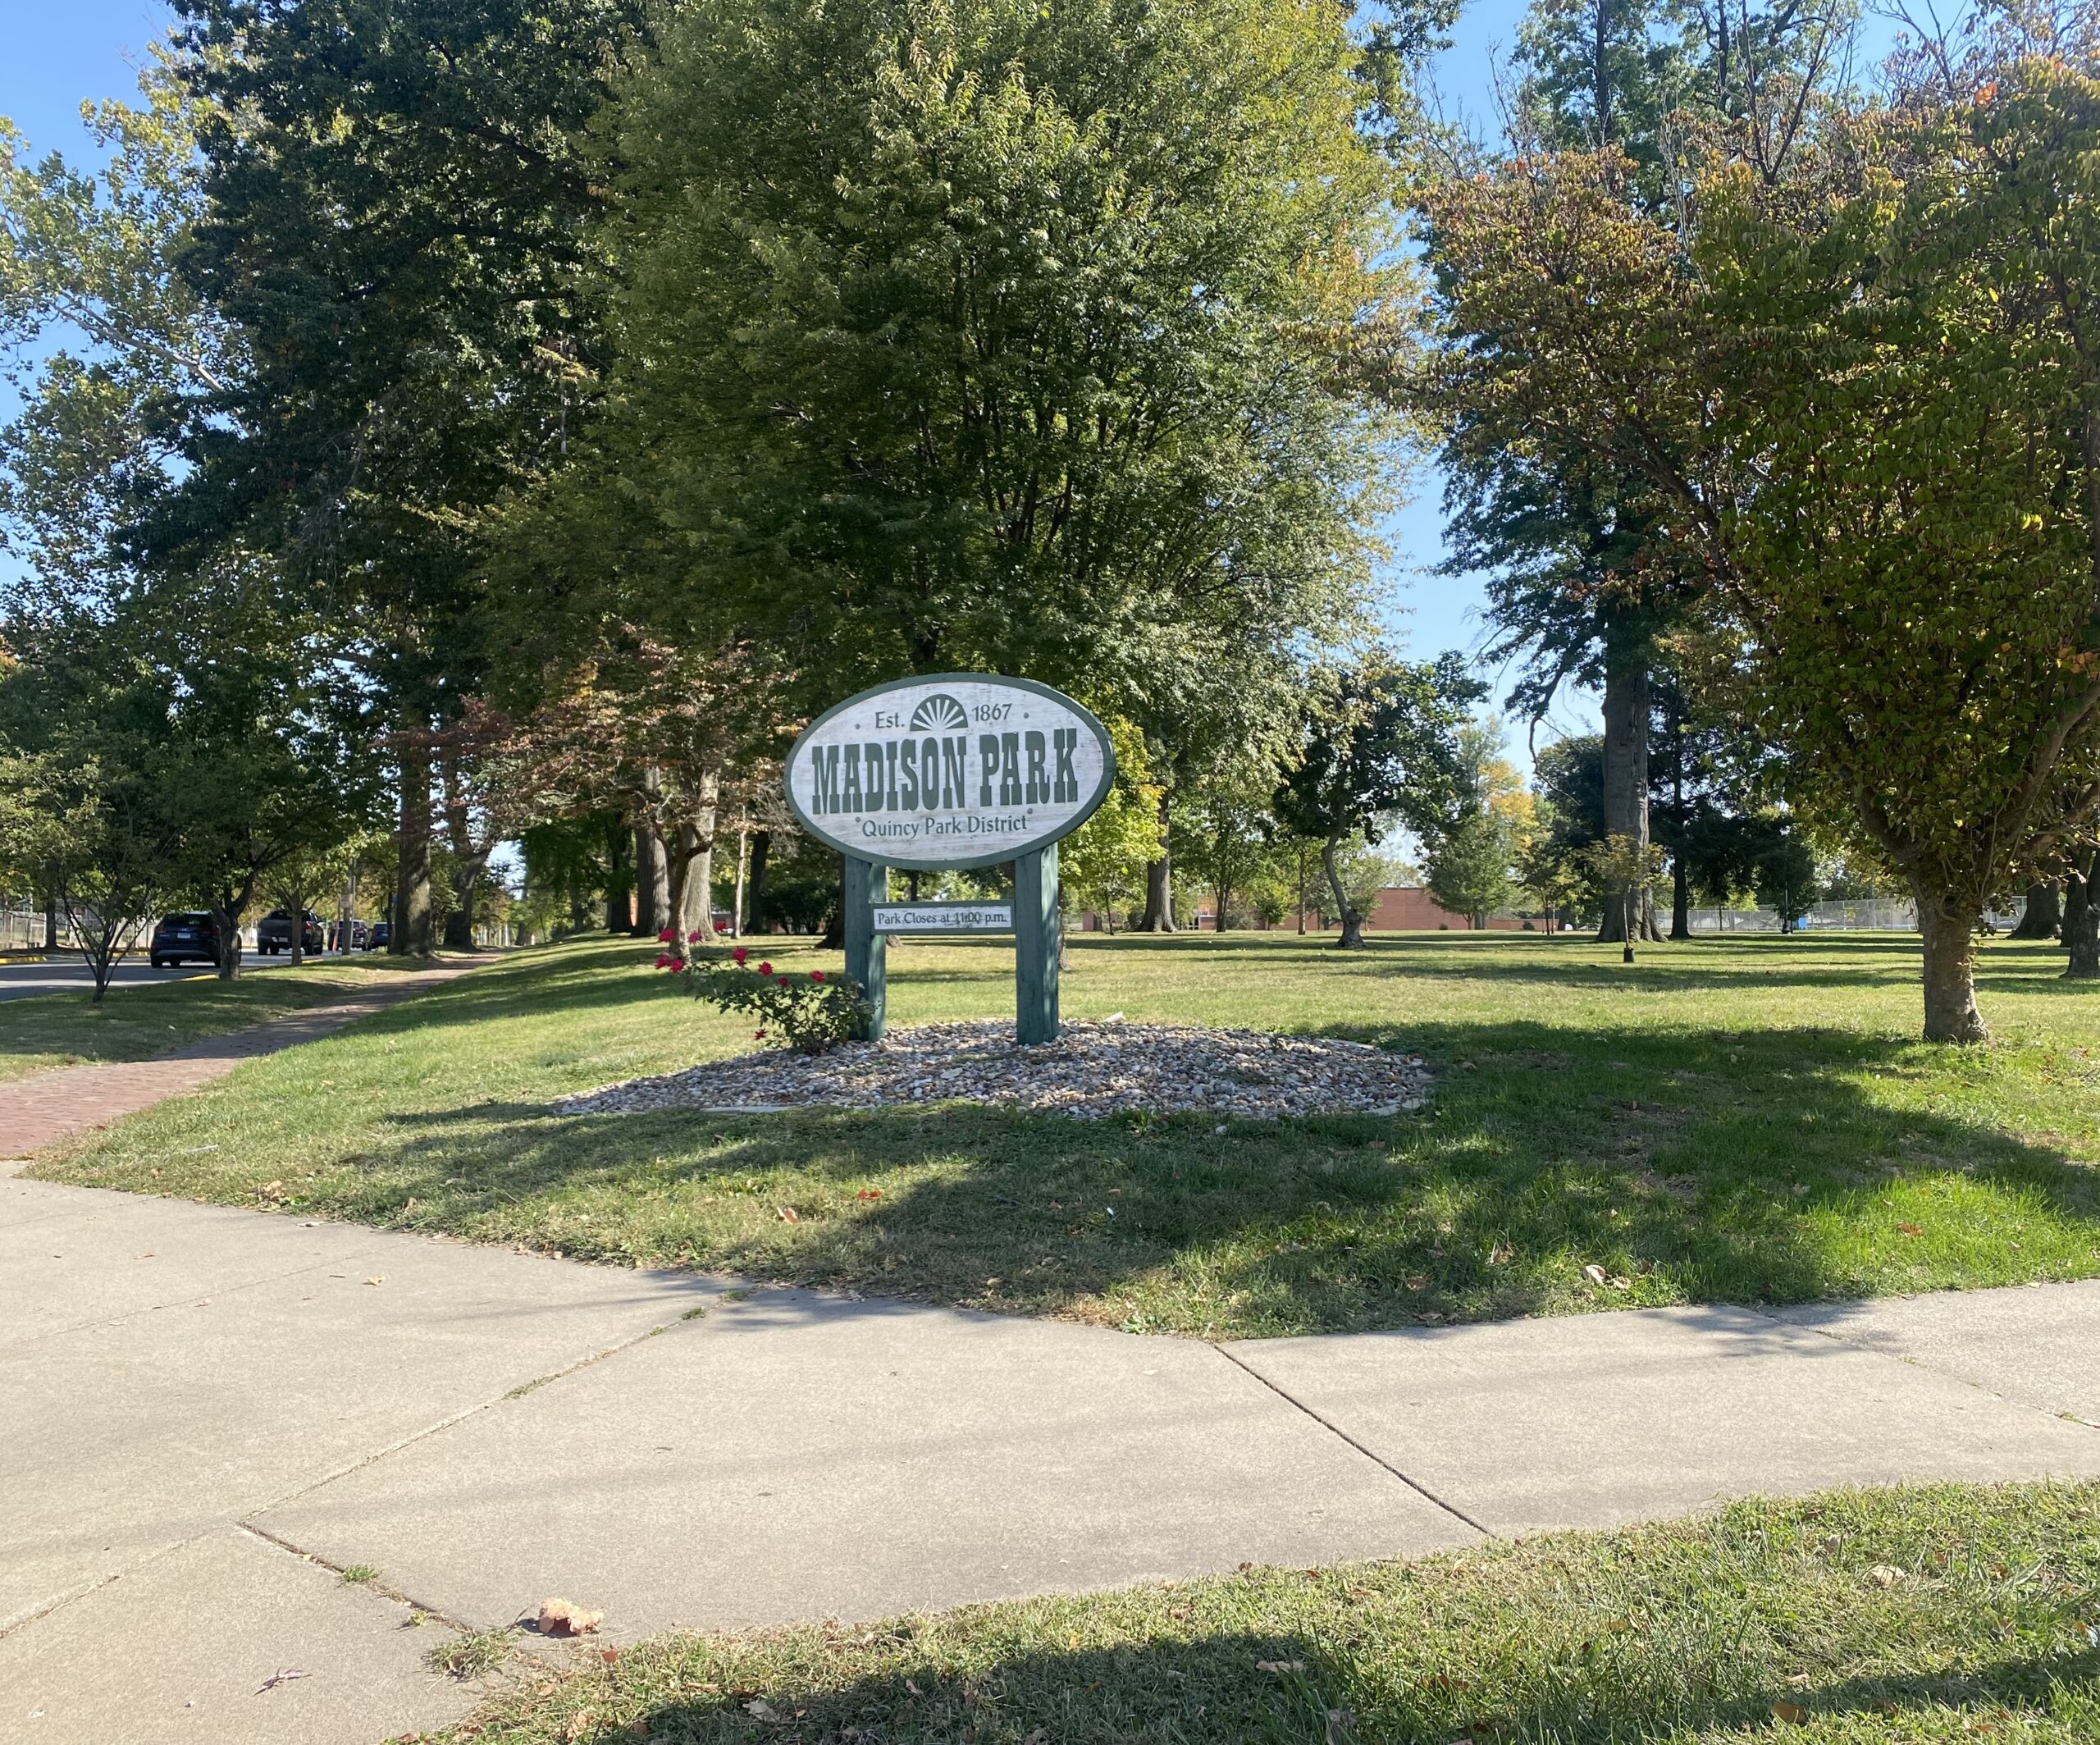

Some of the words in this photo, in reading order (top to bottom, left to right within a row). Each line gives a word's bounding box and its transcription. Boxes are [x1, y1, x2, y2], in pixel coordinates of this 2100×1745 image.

[874, 710, 905, 729] Est.
[971, 703, 1012, 722] 1867
[811, 736, 967, 815] MADISON
[979, 729, 1078, 807] PARK
[862, 818, 919, 839] Quincy
[924, 816, 962, 834] Park
[967, 815, 1027, 834] District
[878, 913, 901, 925] Park
[903, 912, 937, 924] Closes
[940, 913, 950, 923] at
[985, 912, 1007, 925] p.m.
